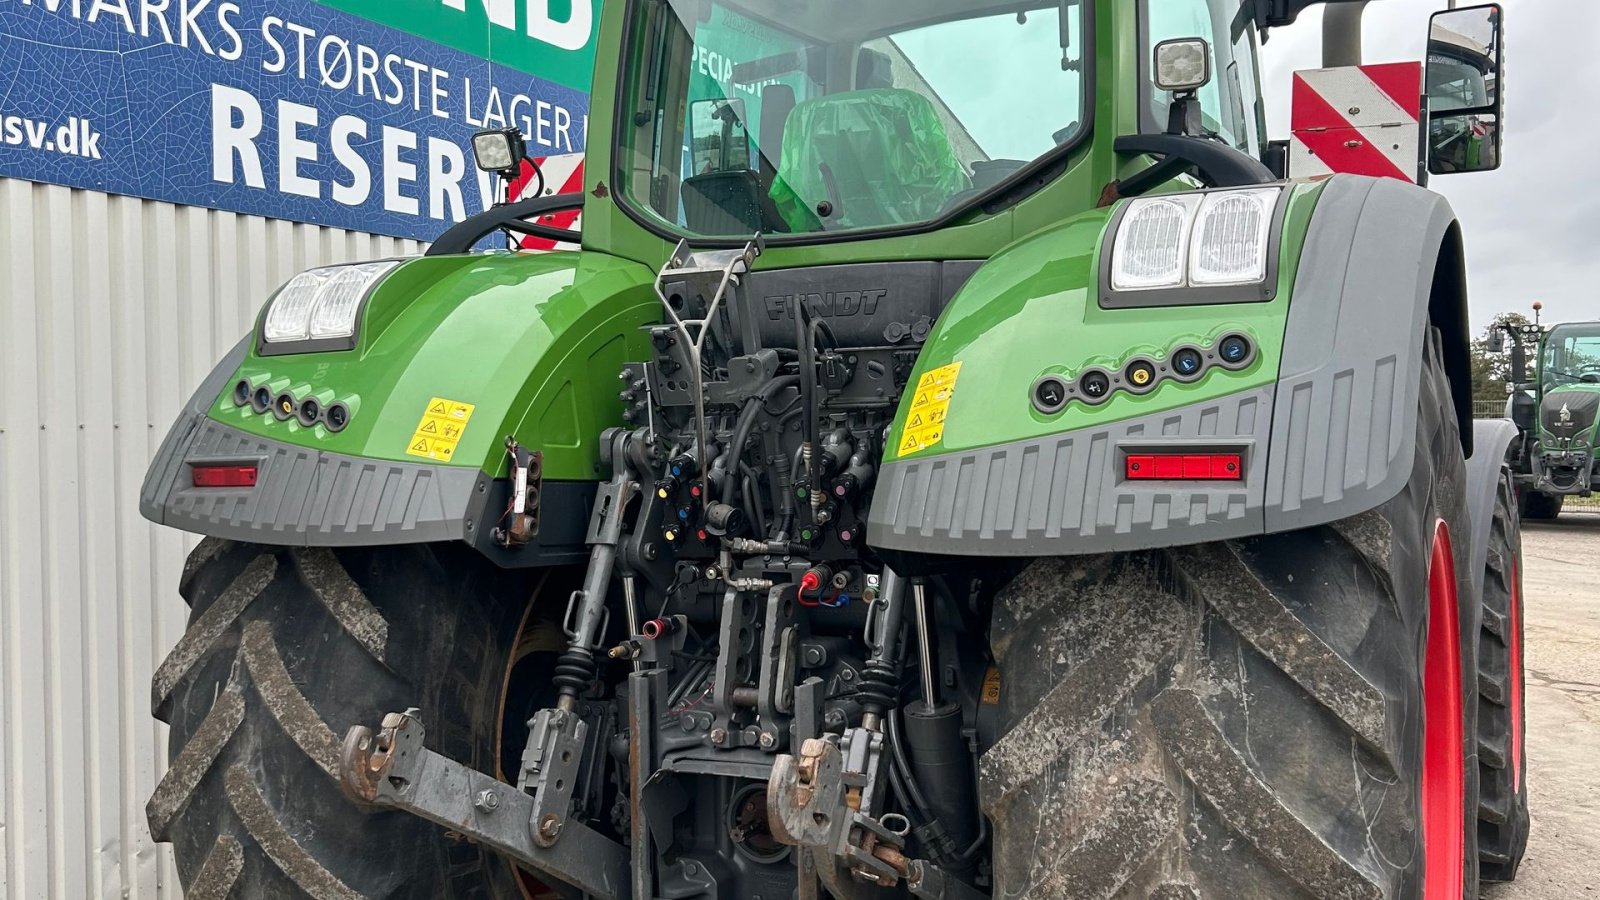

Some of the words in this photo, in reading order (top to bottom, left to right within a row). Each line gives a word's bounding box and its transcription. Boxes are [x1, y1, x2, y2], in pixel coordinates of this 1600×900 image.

[262, 16, 450, 119] STØRSTE
[464, 77, 573, 153] LAGER
[0, 114, 102, 160] sv.dk
